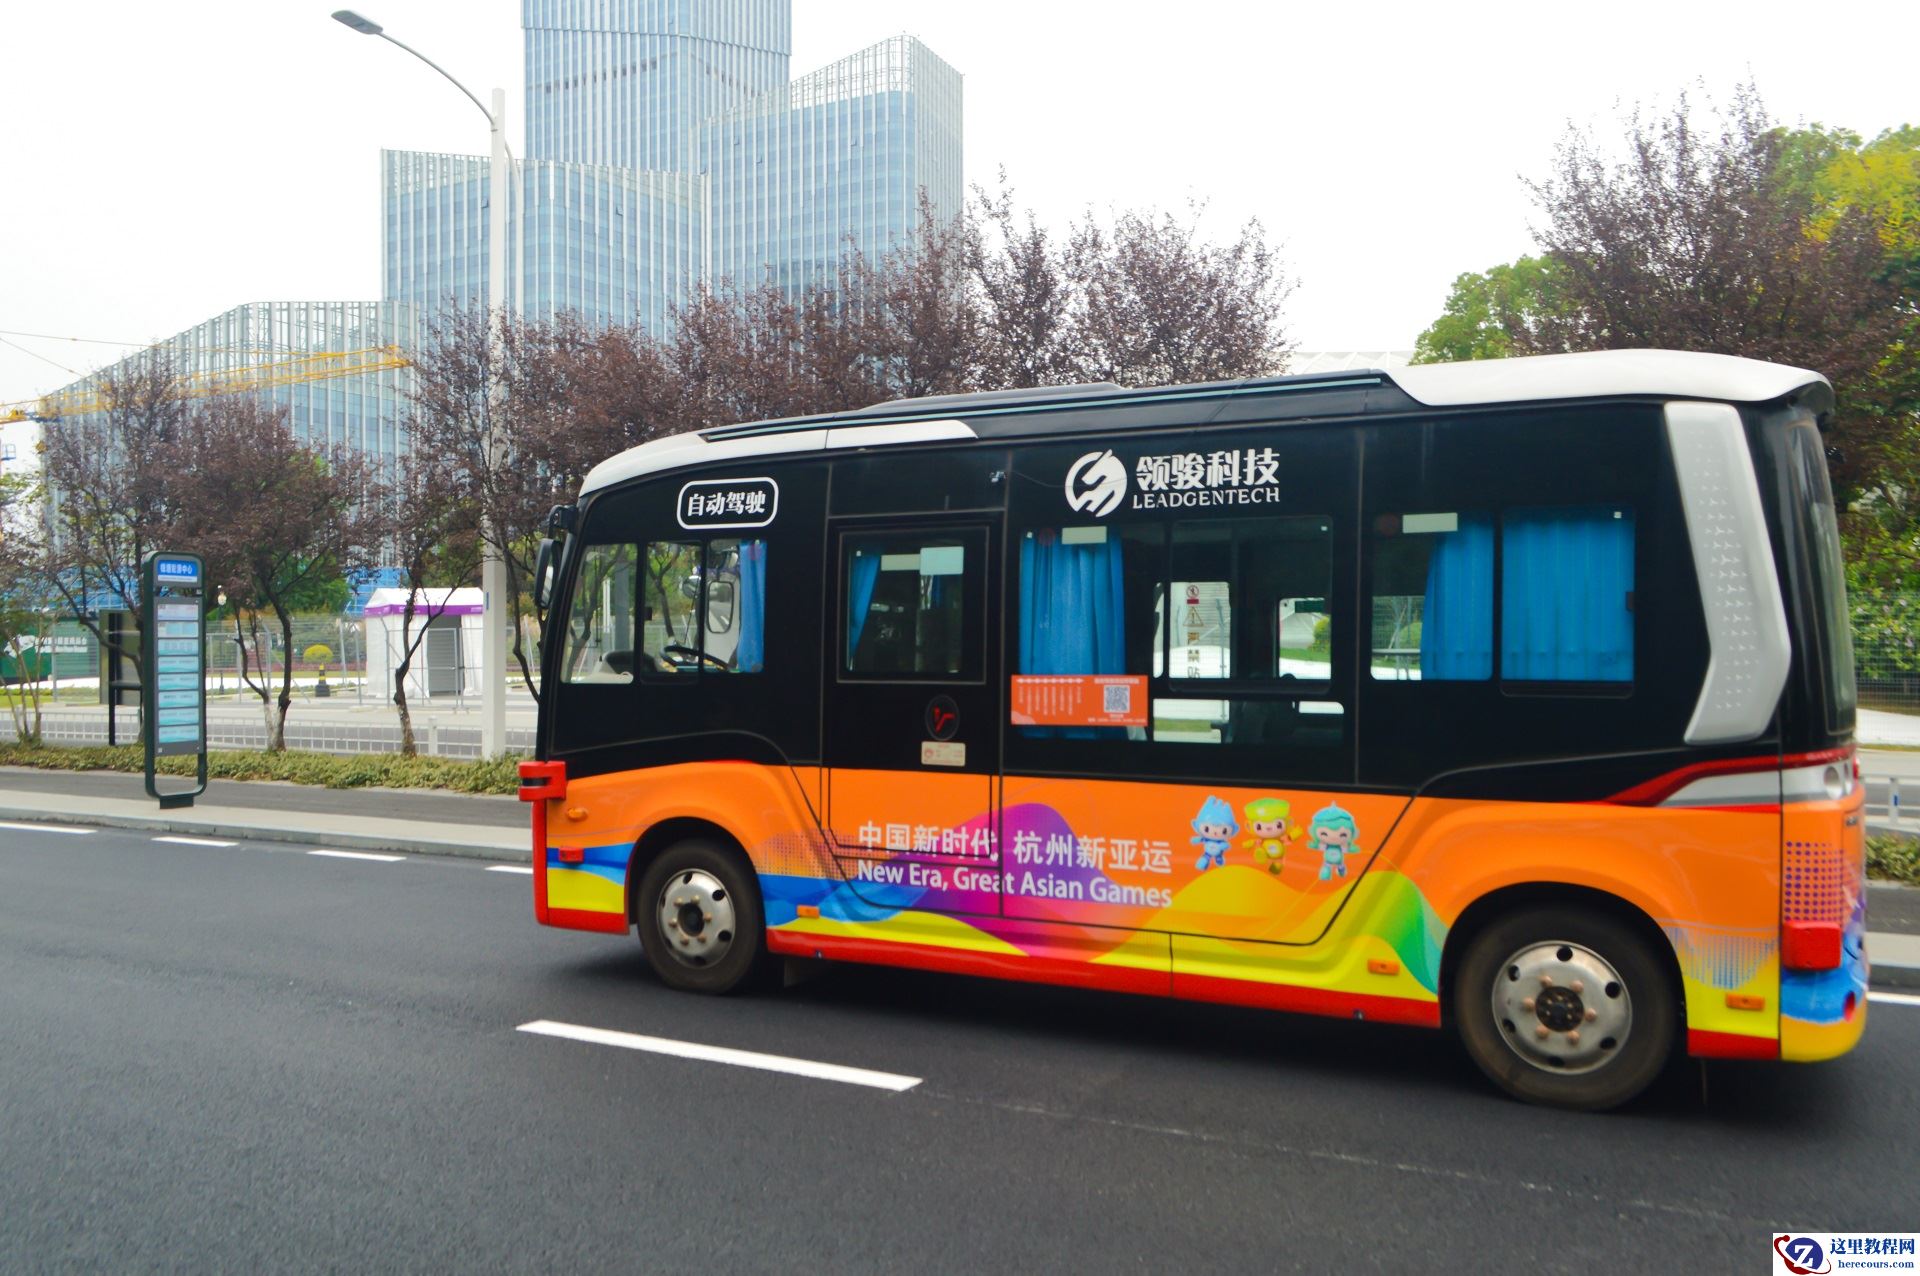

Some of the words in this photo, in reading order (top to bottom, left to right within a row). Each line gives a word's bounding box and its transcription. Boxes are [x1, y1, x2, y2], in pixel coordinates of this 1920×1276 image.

[1136, 448, 1280, 491] 领骏科技
[687, 490, 766, 517] 自动驾驶
[1132, 487, 1280, 509] LEADGENTECH
[857, 820, 998, 862] 中国新时代
[1013, 829, 1172, 874] 杭州新亚运
[857, 859, 904, 884] New
[908, 863, 949, 892] Era,
[953, 867, 1015, 895] Great
[1020, 871, 1083, 899] Asian
[1089, 877, 1173, 909] Games
